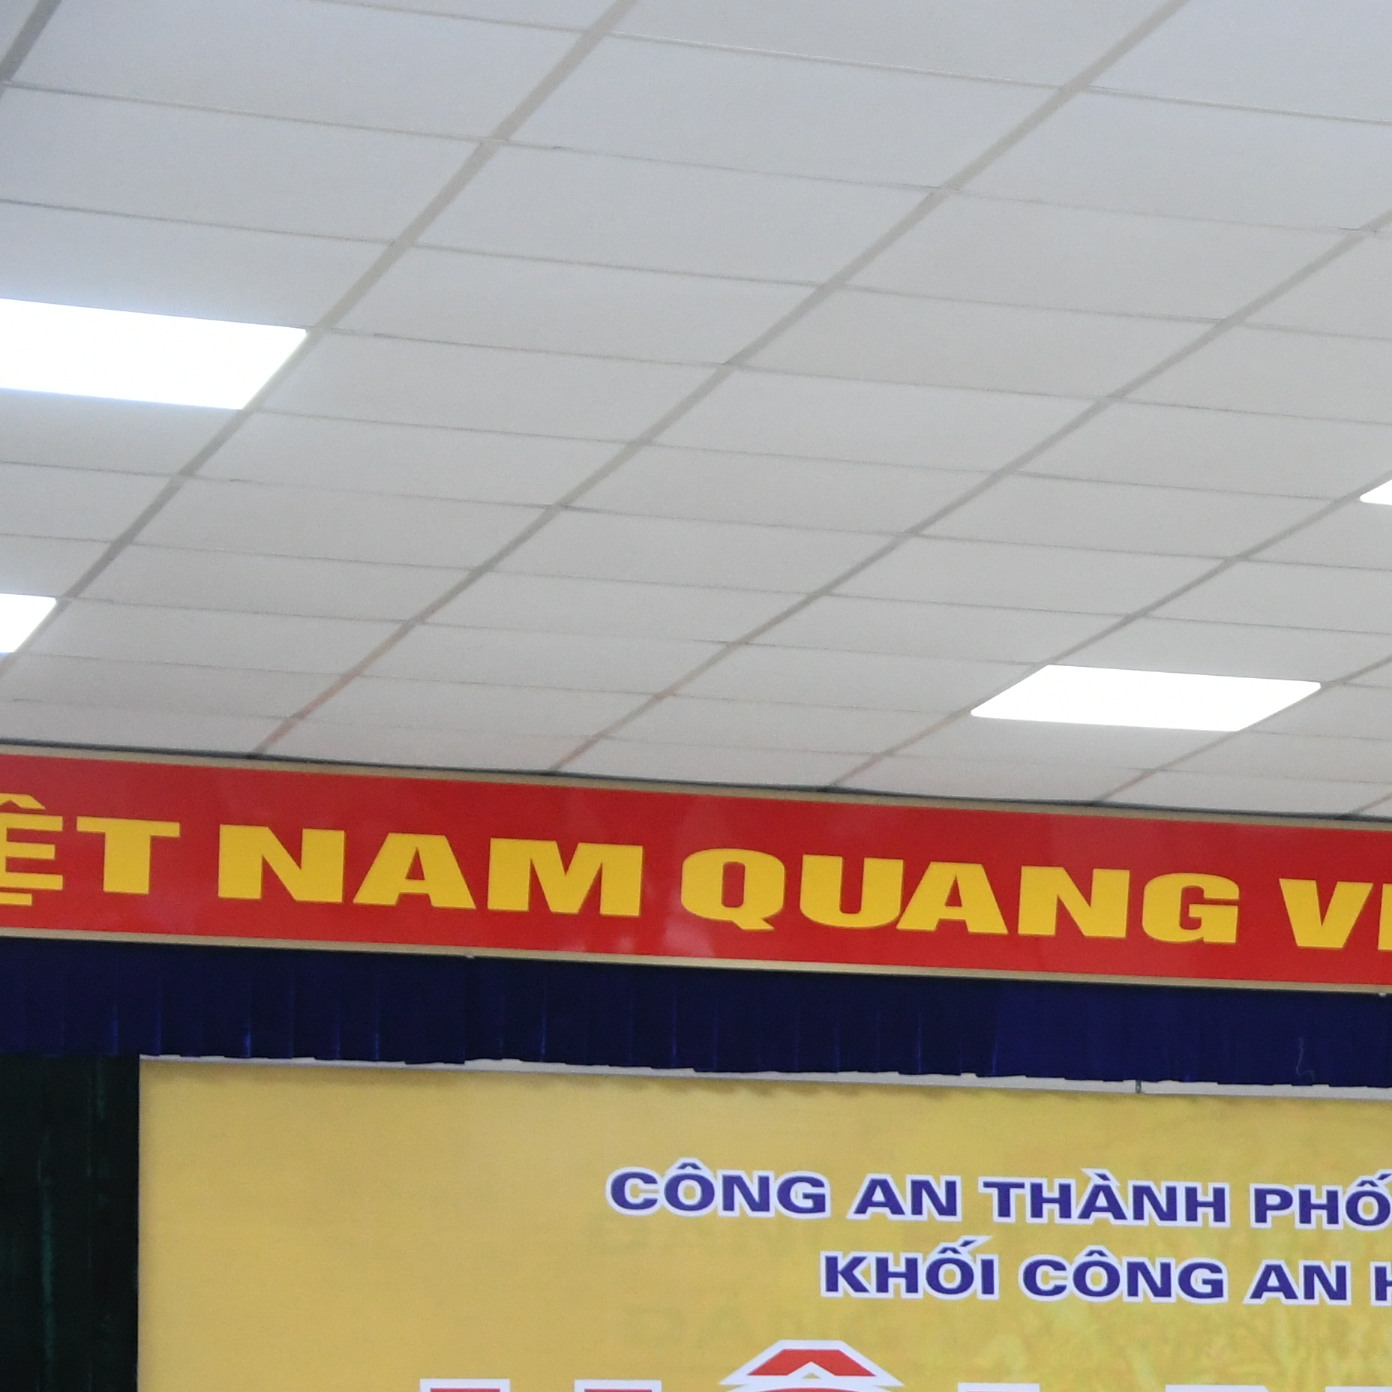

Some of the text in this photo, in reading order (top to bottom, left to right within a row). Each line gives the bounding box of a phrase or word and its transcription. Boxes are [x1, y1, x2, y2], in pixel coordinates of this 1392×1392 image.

[218, 822, 644, 919] NAM
[679, 845, 1240, 945] QUANG
[608, 1159, 829, 1218] CÔNG
[849, 1174, 961, 1220] AN
[980, 1169, 1230, 1226] THÀNH
[821, 1237, 997, 1298] KHỐI
[1020, 1246, 1226, 1303] CÔNG
[1247, 1260, 1349, 1304] AN
